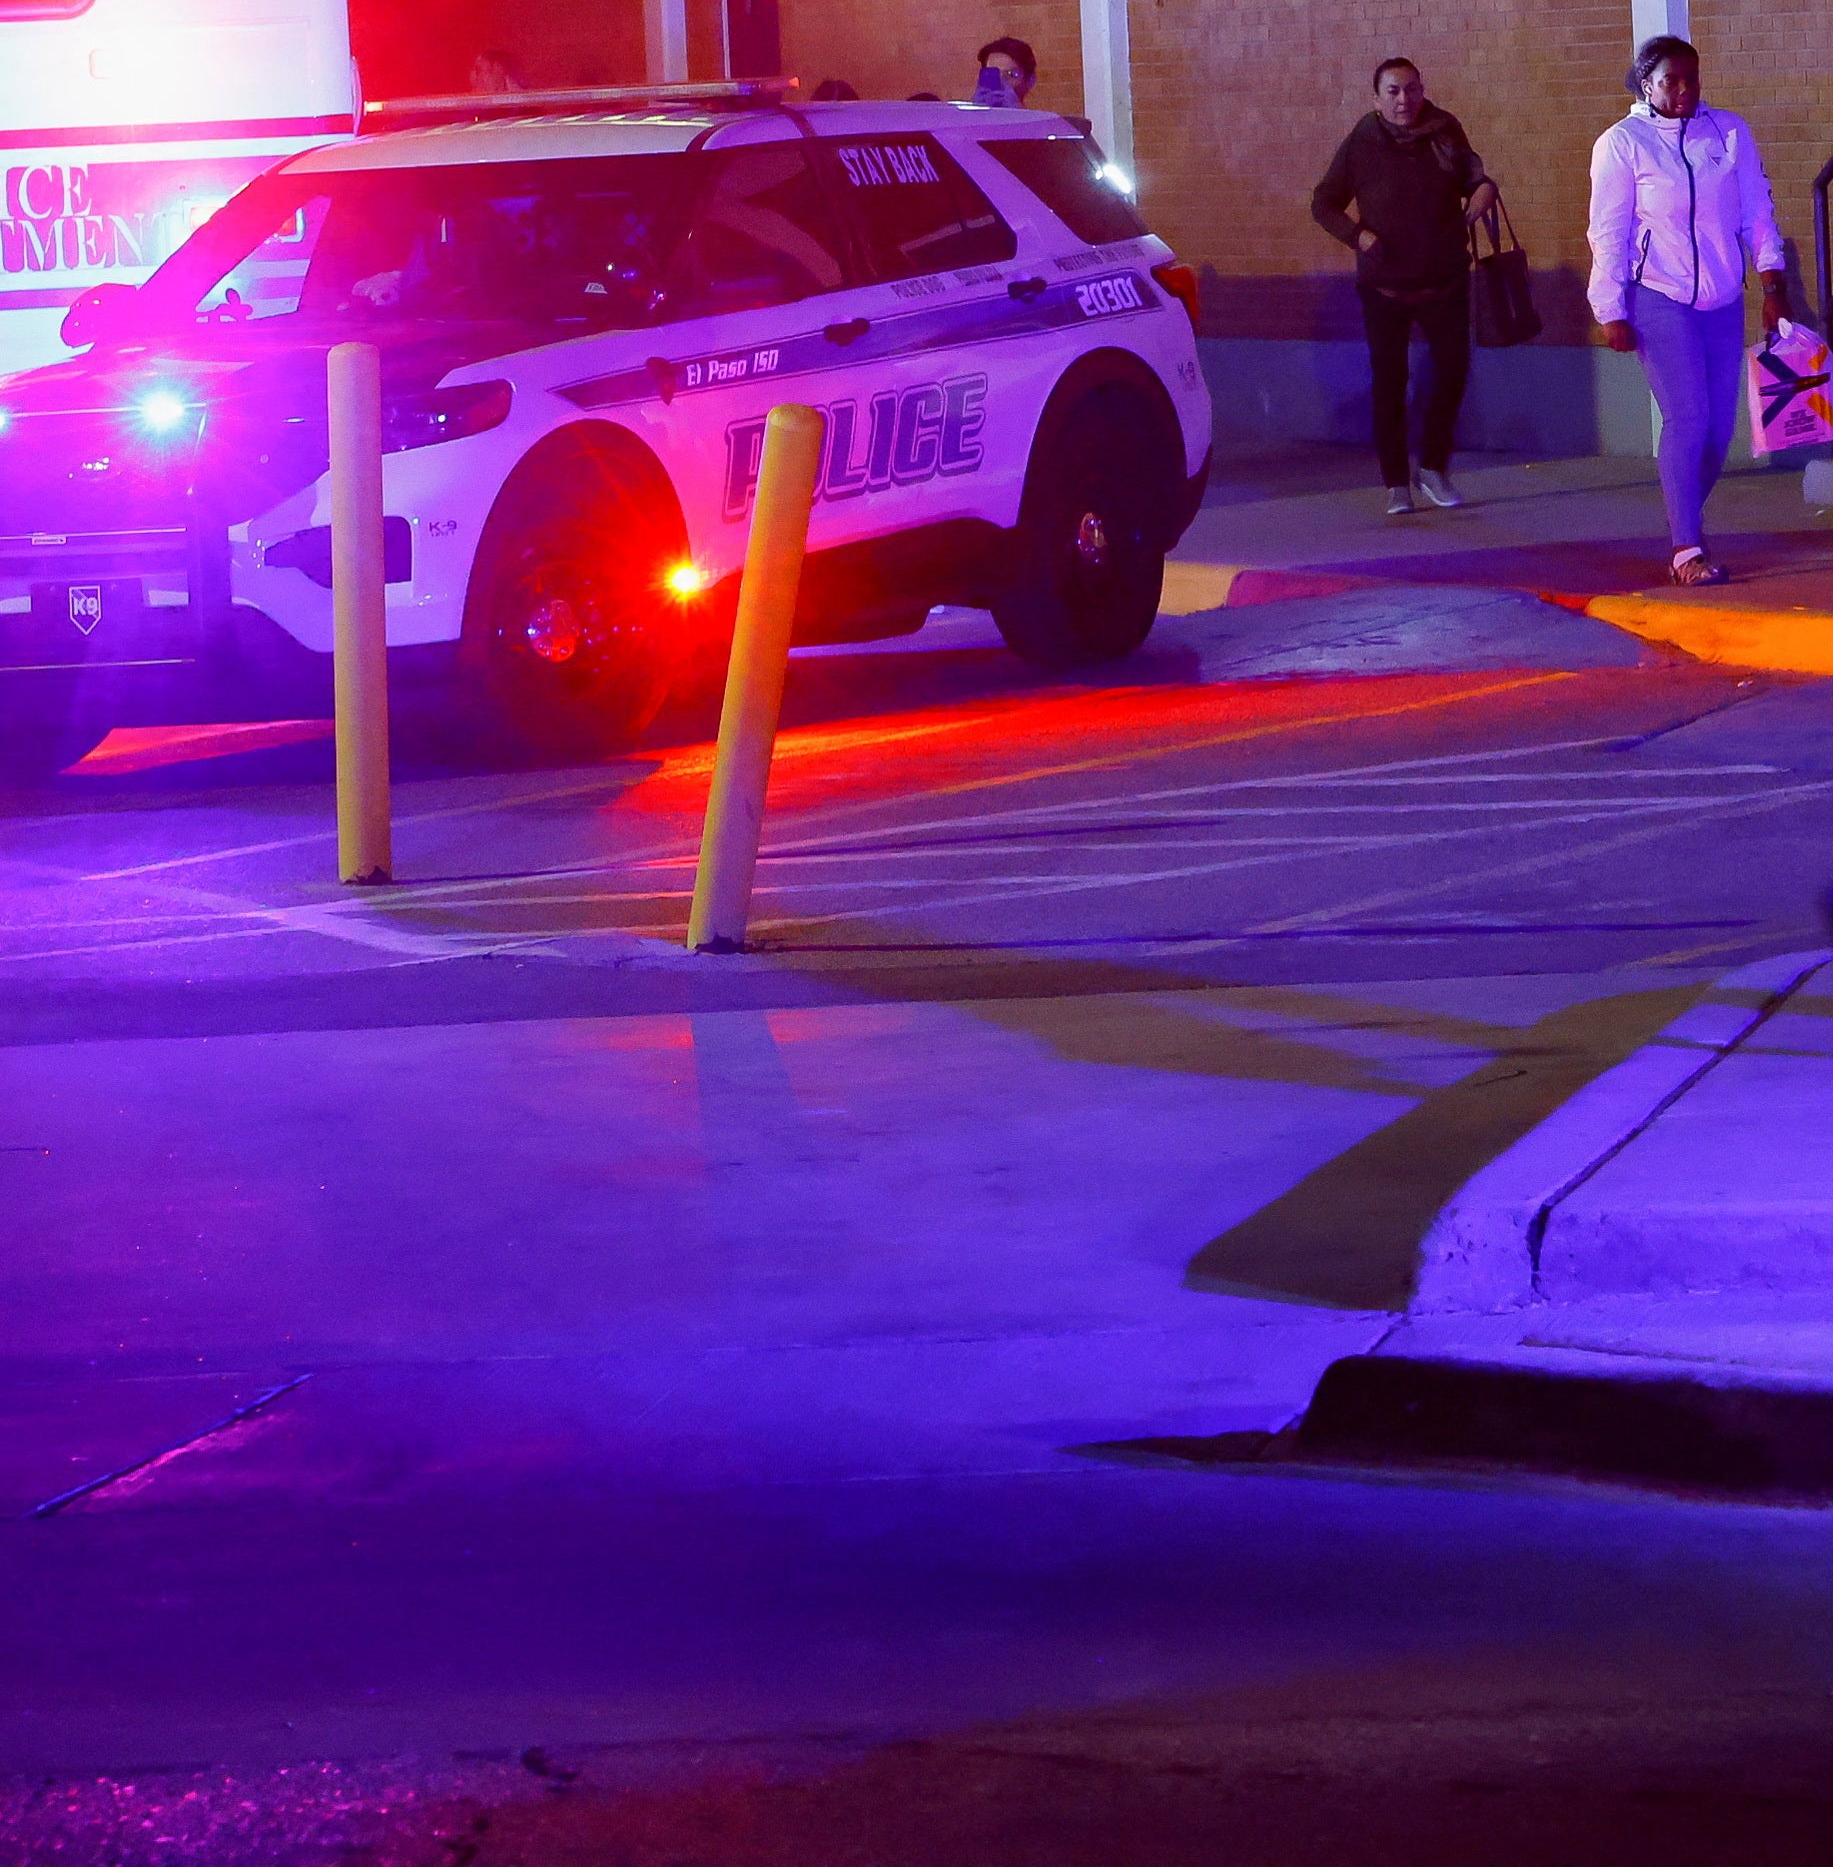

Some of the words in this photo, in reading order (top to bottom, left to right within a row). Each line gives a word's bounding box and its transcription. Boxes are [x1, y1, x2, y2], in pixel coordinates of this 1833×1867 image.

[838, 146, 892, 187] STAY
[884, 144, 941, 184] BACK
[1075, 276, 1143, 318] 20301
[686, 363, 702, 387] El
[707, 360, 747, 383] Paso
[752, 349, 779, 373] ISD
[722, 372, 988, 523] PLICE
[73, 596, 98, 616] K9
